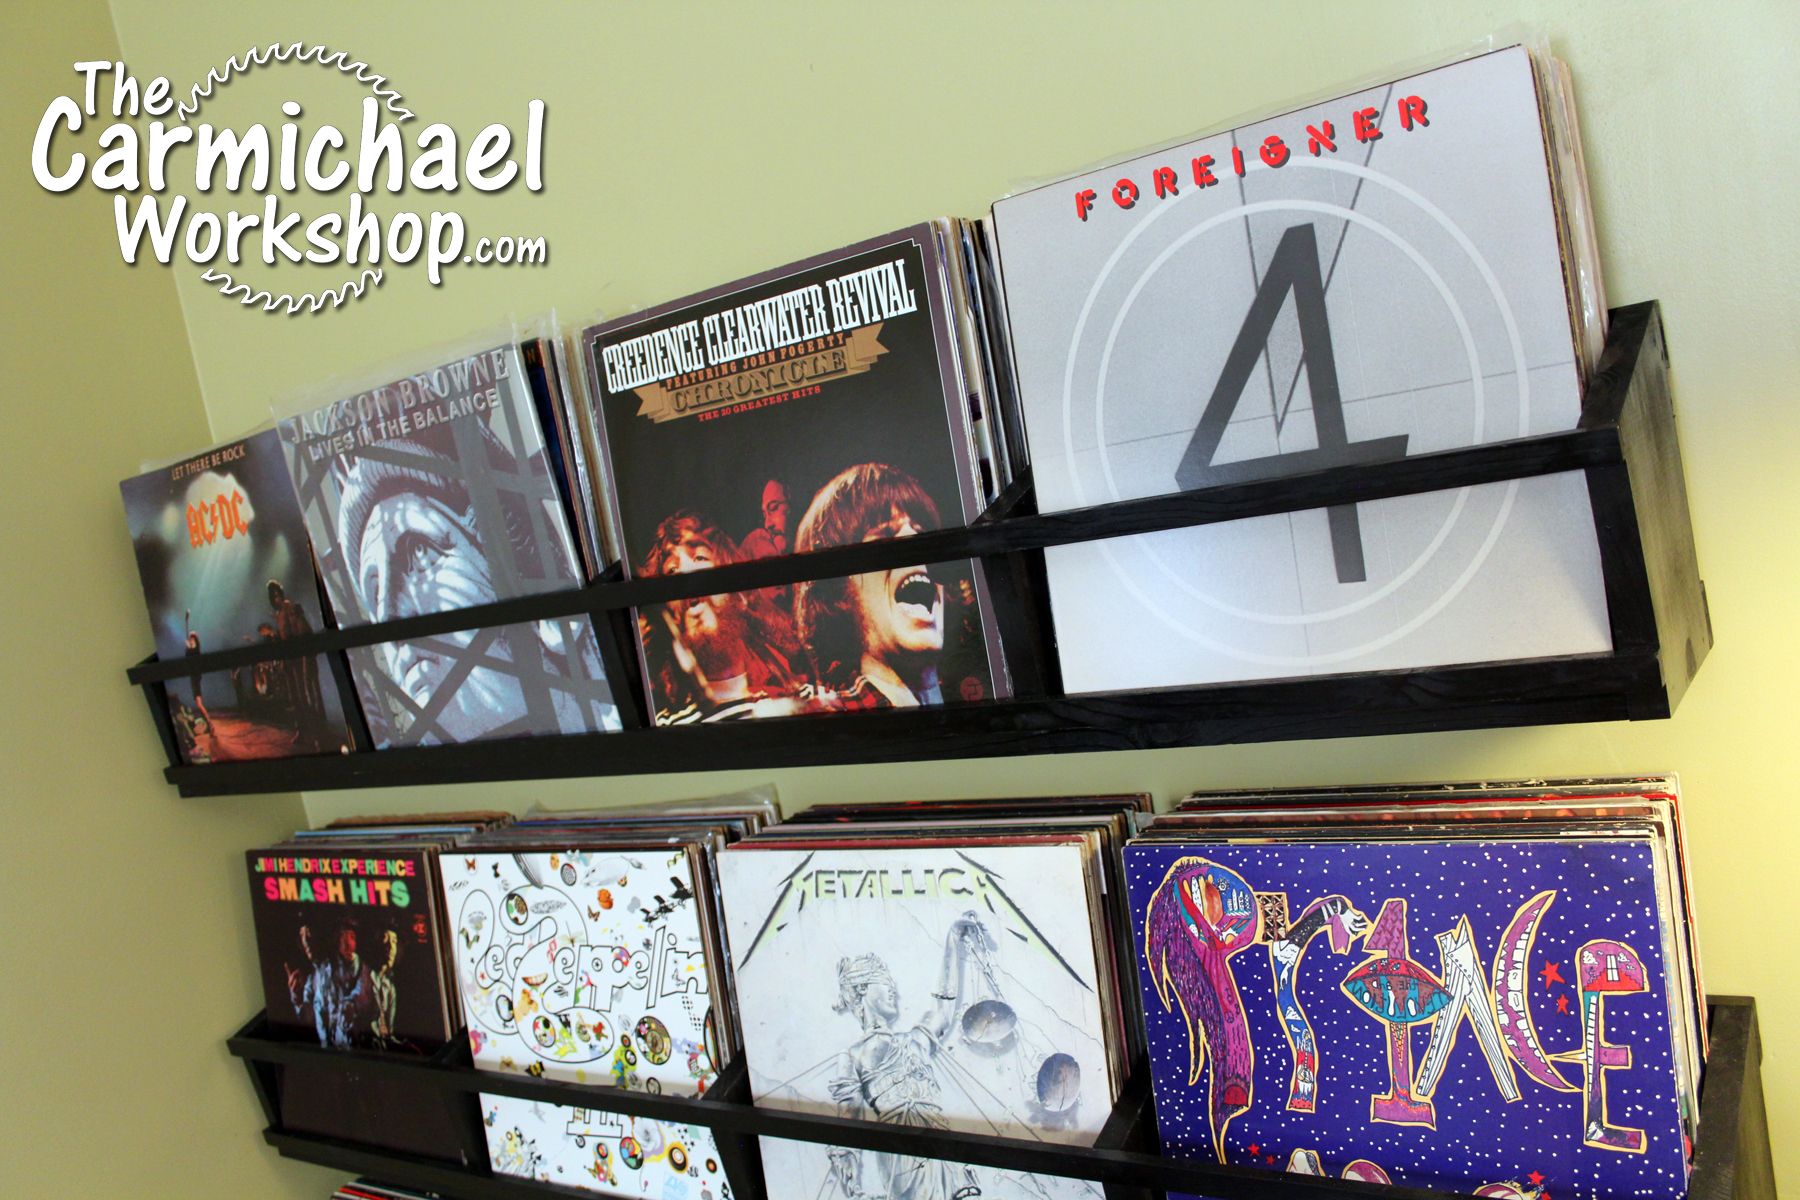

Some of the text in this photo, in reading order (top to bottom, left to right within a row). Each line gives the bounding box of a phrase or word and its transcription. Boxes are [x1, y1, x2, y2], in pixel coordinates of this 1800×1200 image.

[1075, 95, 1430, 222] FOREIGNER
[602, 258, 918, 394] CREEDENCE CLEARWATER REVIVAL
[666, 333, 846, 390] FEATURING JOHN FOGERTY
[672, 350, 848, 413] CHRONICLE
[291, 348, 509, 445] JACKSON BROWNE
[308, 388, 500, 463] LIVES IN THE BALANCE
[697, 385, 821, 422] THE 20 GREATEST HITS
[1175, 222, 1409, 583] 4
[171, 444, 246, 480] LET THERE BE ROCK
[255, 857, 416, 877] JIMI HENDRIX EXPERIENCE
[264, 876, 410, 908] SMASH HITS
